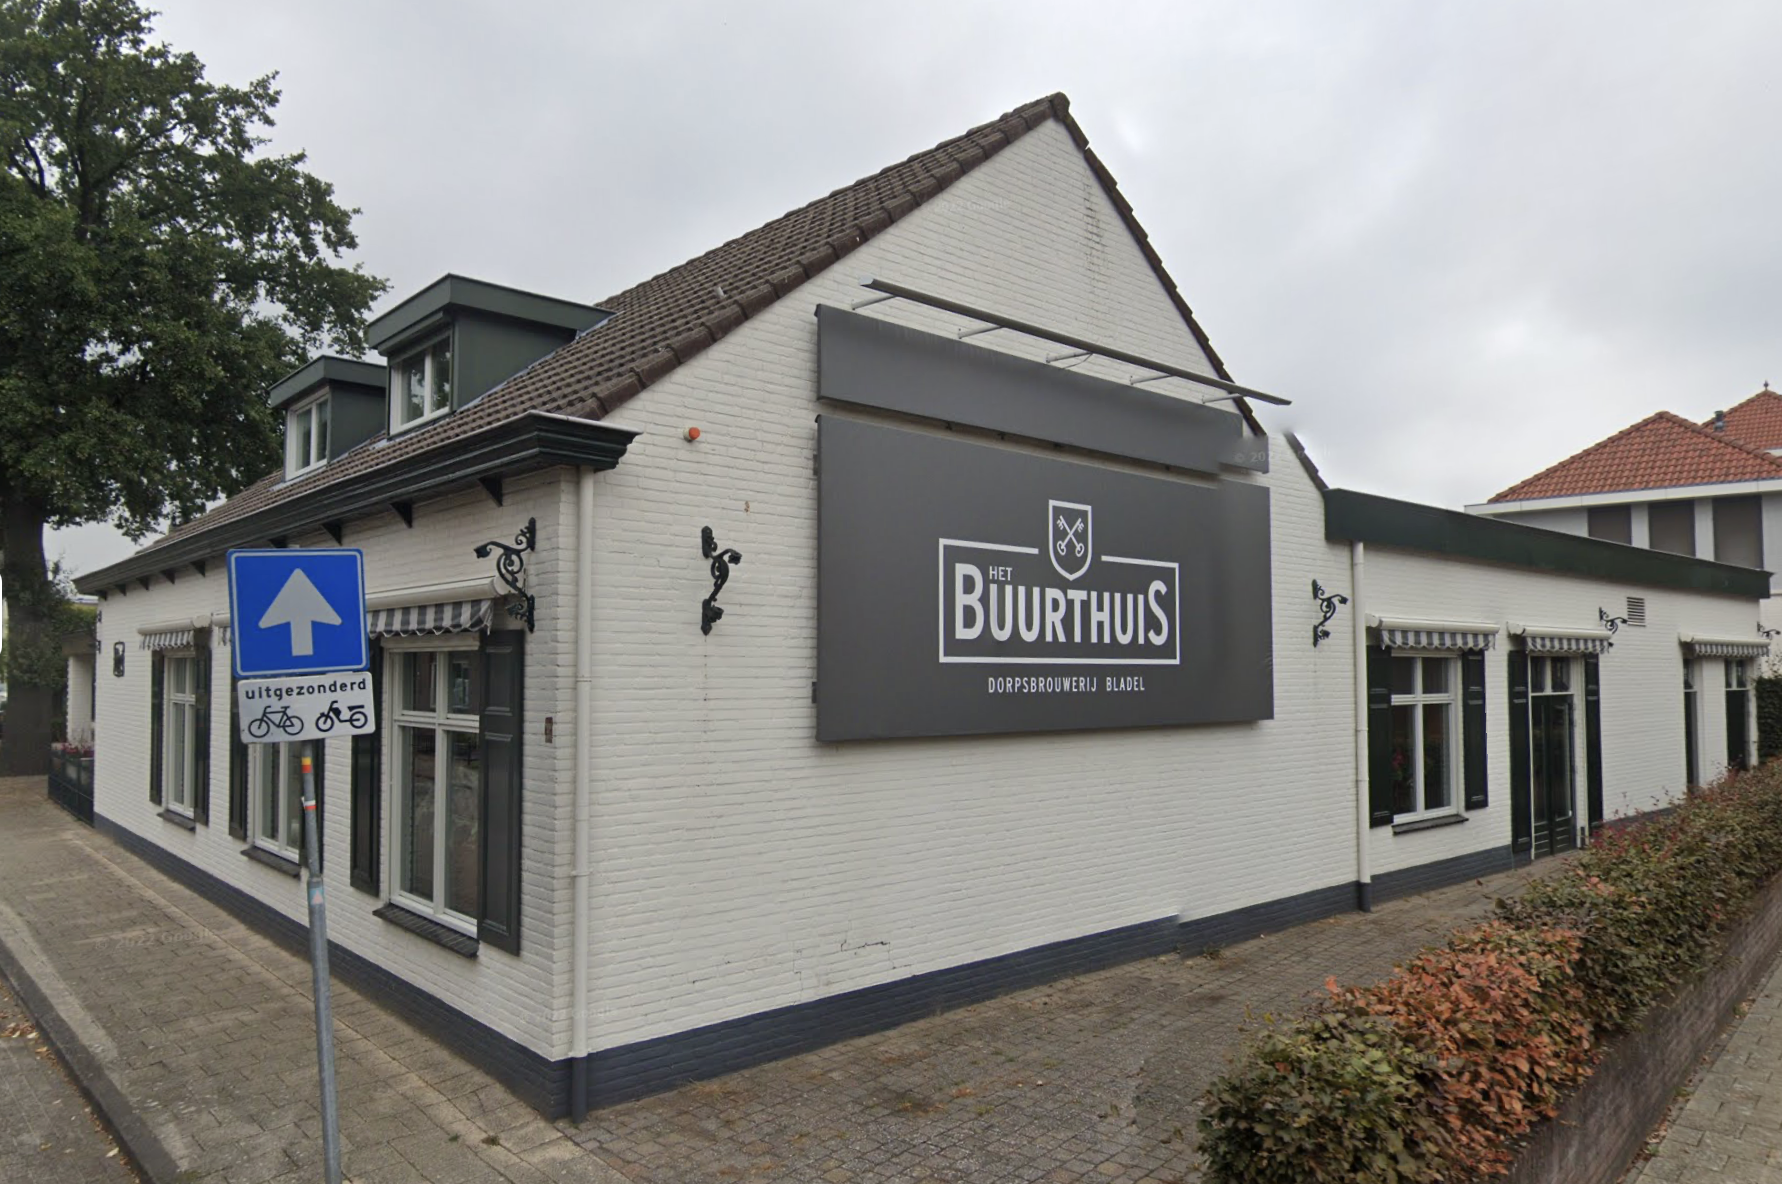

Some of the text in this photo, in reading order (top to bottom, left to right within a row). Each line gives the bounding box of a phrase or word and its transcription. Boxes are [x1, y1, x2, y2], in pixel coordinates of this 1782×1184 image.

[989, 566, 1013, 581] HET
[955, 562, 1169, 646] BUURTHUIS
[244, 678, 367, 701] uitgezonderd
[988, 676, 1145, 693] DORPSBROUWERIJ BLADEL
